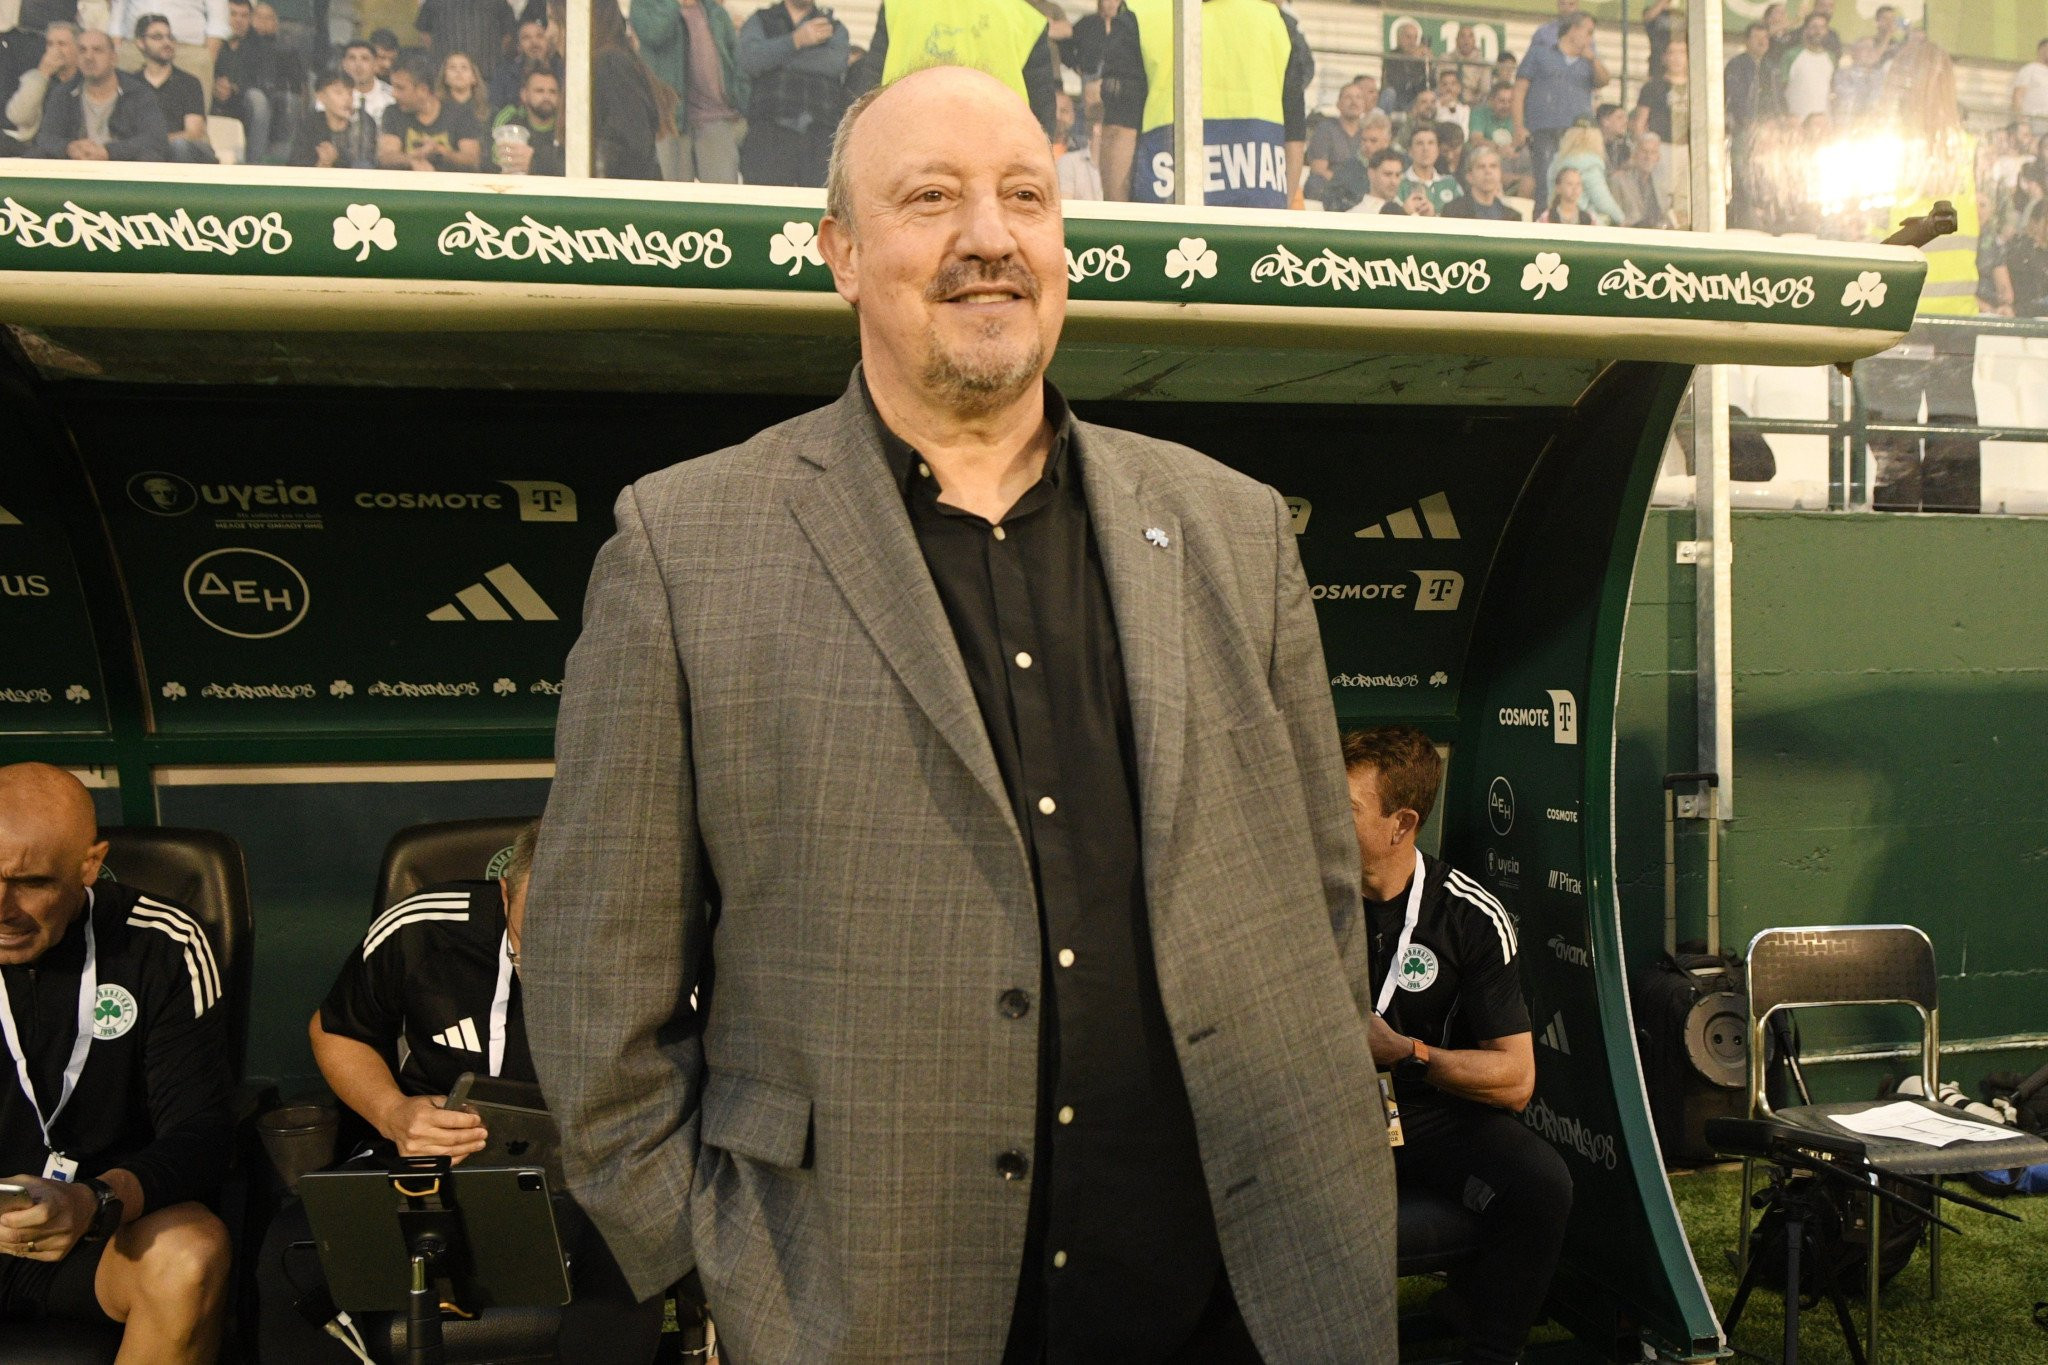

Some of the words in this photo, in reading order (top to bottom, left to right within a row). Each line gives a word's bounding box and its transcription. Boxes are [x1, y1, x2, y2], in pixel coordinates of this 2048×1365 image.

[1152, 141, 1287, 198] SEWAR
[438, 211, 732, 270] @BORNIN1908
[1251, 245, 1491, 294] @BORNIN1908
[1598, 259, 1815, 308] @BORNIN1908
[354, 492, 503, 510] COSMOTE
[0, 575, 50, 597] us
[1309, 584, 1407, 600] OSMOTE
[1500, 708, 1549, 727] COSMOTE
[1546, 808, 1578, 823] COSMOTE
[1524, 1097, 1617, 1169] BORNIN1908
